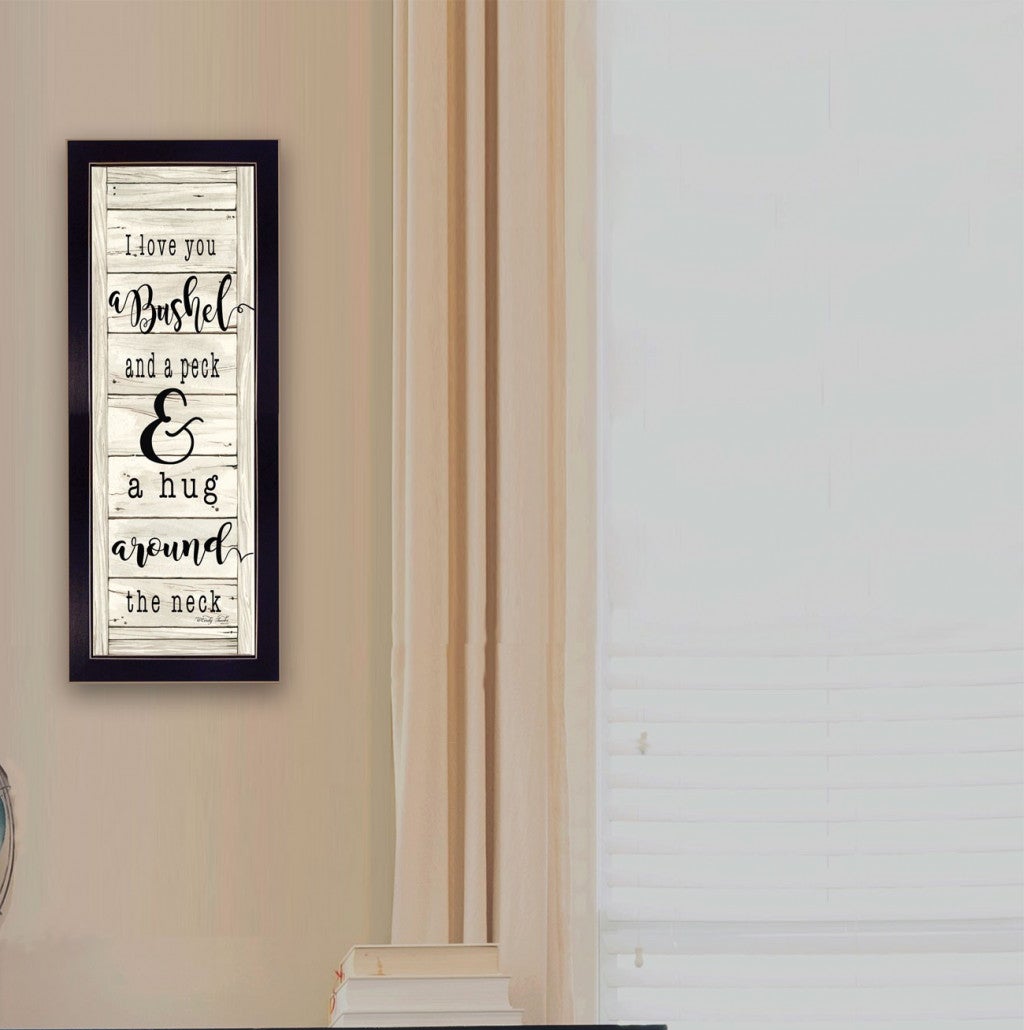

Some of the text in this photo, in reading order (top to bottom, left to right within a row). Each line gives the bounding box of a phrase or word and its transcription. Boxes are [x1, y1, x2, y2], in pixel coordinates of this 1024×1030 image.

[125, 233, 216, 262] I love you
[108, 274, 253, 334] a Bushel
[125, 352, 220, 384] and a peck
[139, 387, 204, 465] &
[127, 471, 219, 506] a hug
[111, 521, 254, 568] around
[126, 590, 222, 613] the neck
